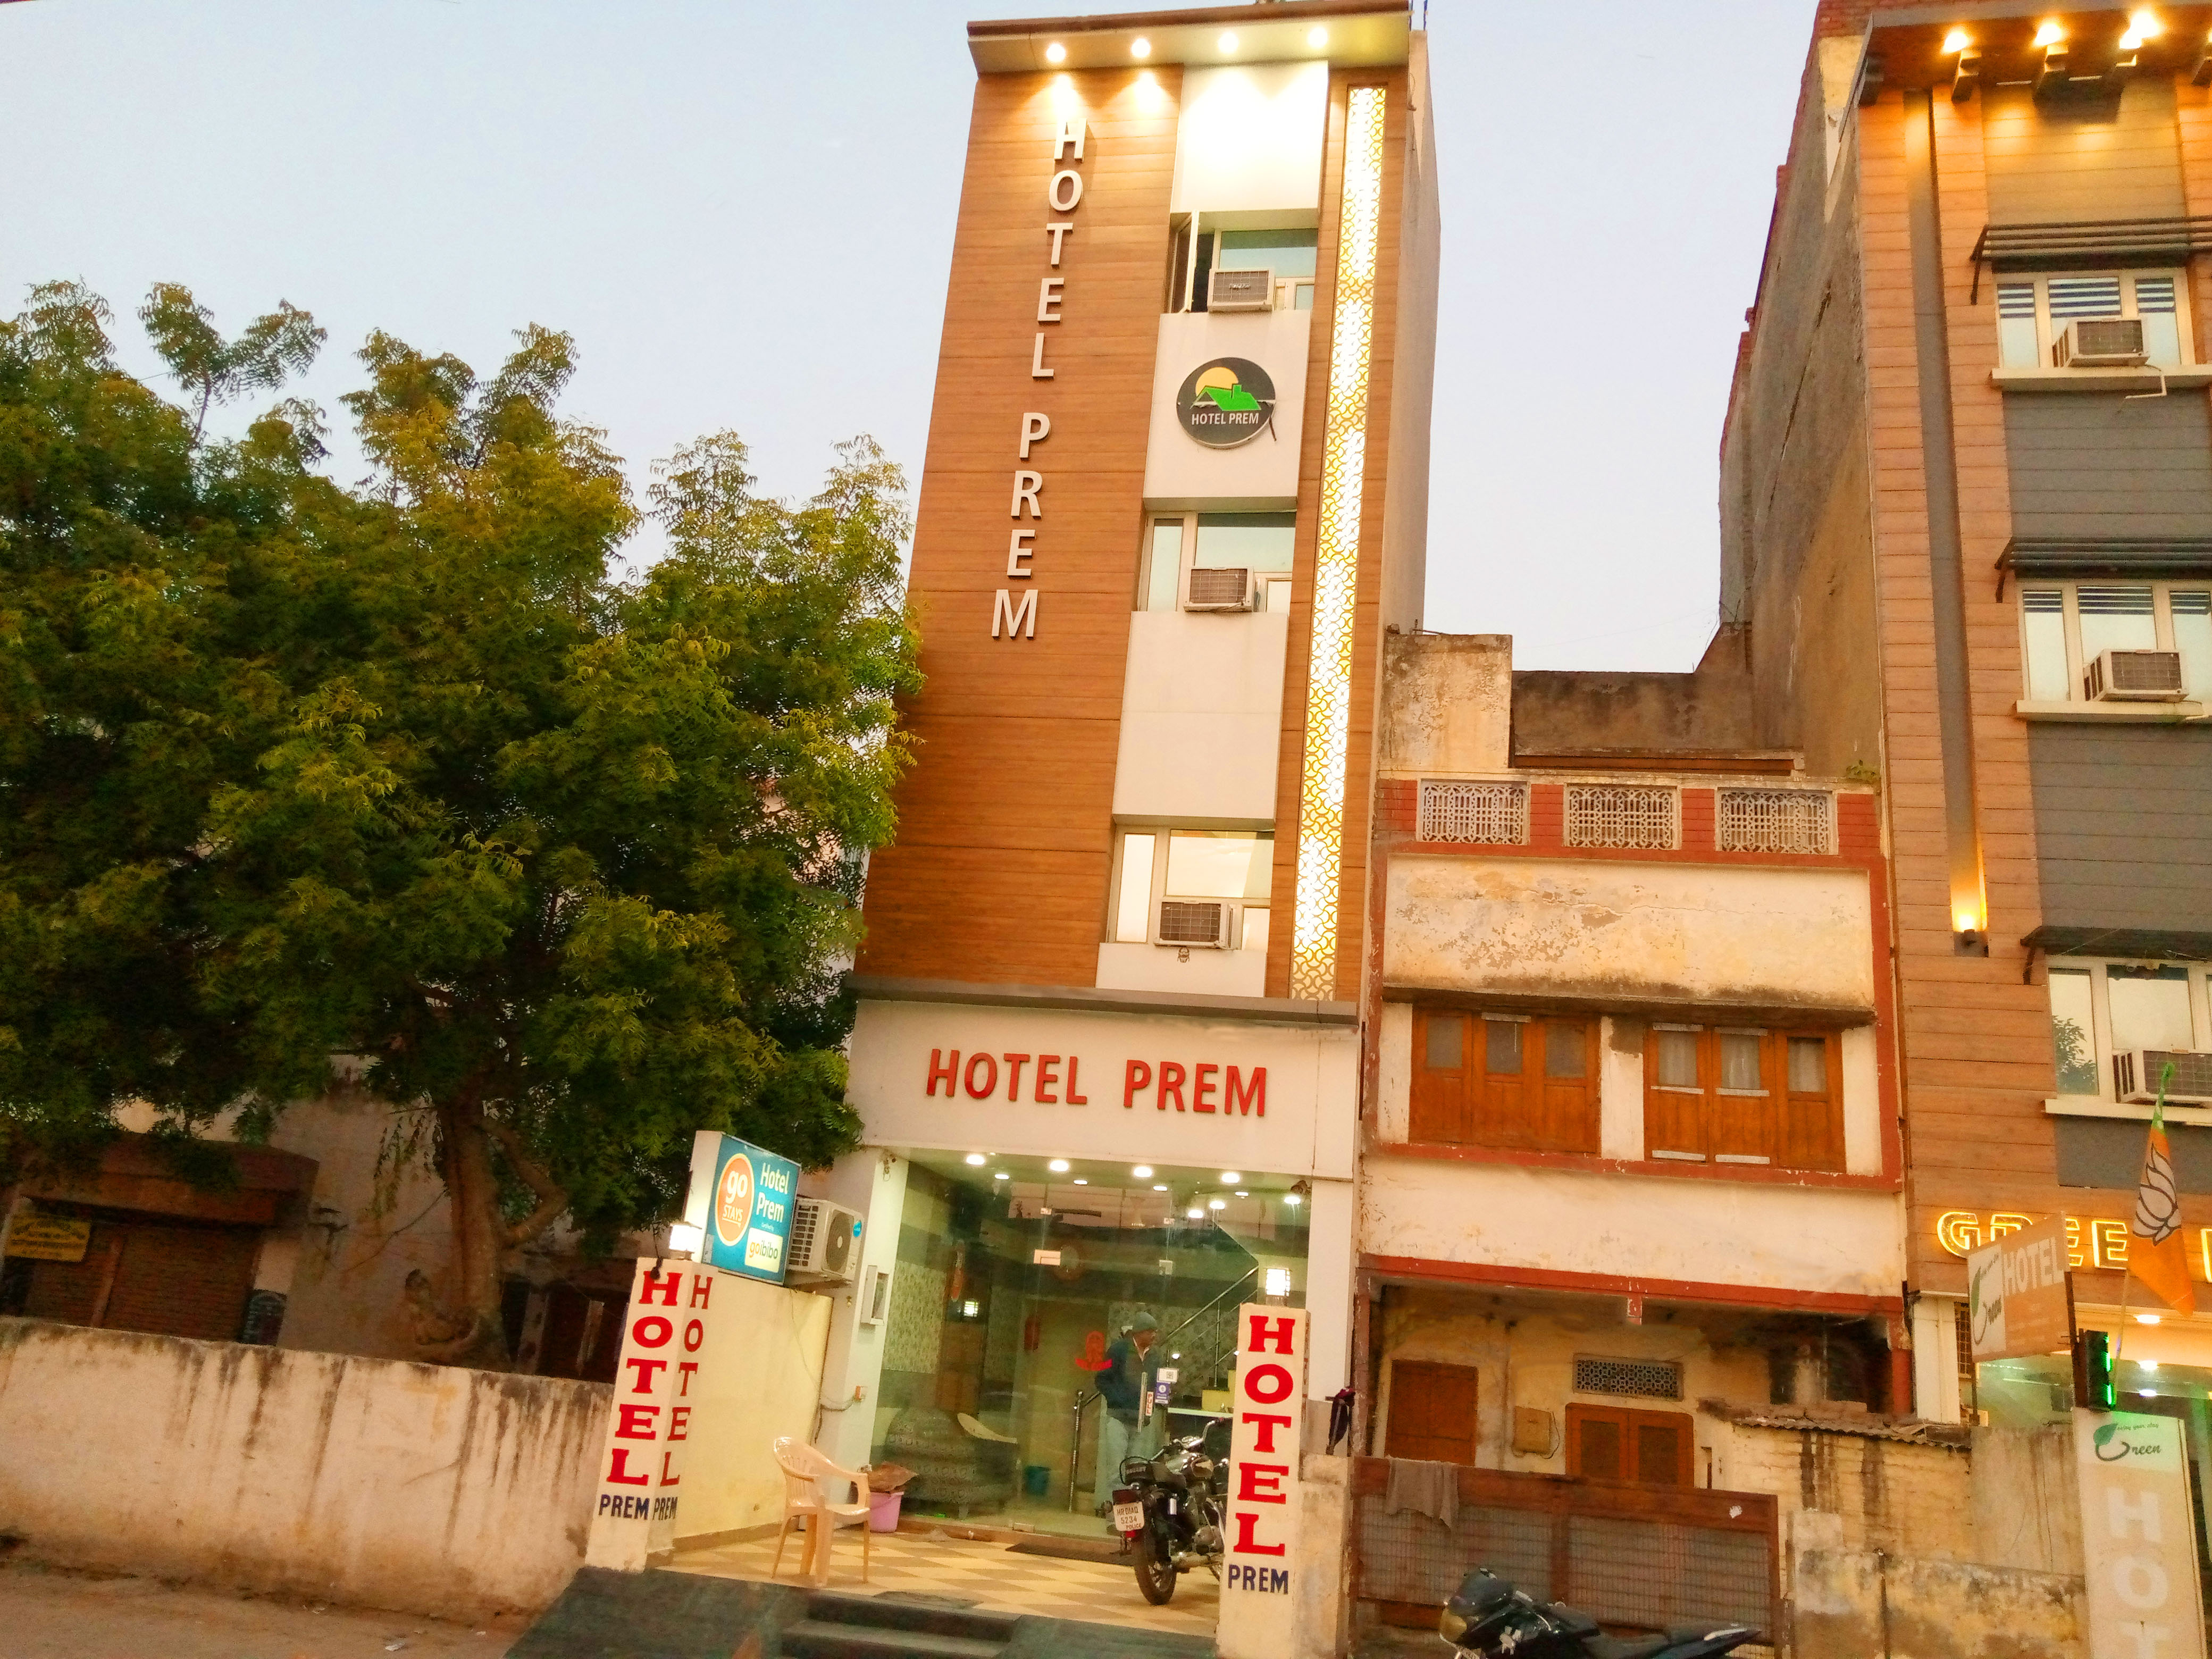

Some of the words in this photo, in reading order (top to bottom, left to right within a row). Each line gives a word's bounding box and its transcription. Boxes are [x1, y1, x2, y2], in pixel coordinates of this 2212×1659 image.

[1032, 118, 1088, 379] HOTEL
[1191, 412, 1226, 425] HOTEL
[1228, 412, 1259, 424] PREM
[991, 412, 1051, 639] PREM
[926, 1049, 1087, 1105] HOTEL
[1124, 1059, 1267, 1117] PREM
[725, 1170, 748, 1204] go
[759, 1162, 790, 1195] Hotel
[723, 1204, 743, 1222] STAYS
[756, 1192, 784, 1223] Prem
[749, 1239, 778, 1260] goibibo
[2003, 1236, 2065, 1296] HOTEL
[606, 1270, 683, 1486] HOTEL
[659, 1275, 713, 1487] HOTEL
[1233, 1315, 1296, 1557] HOTEL
[598, 1494, 650, 1521] PREM
[652, 1496, 678, 1521] PREM
[1227, 1564, 1289, 1595] PREM
